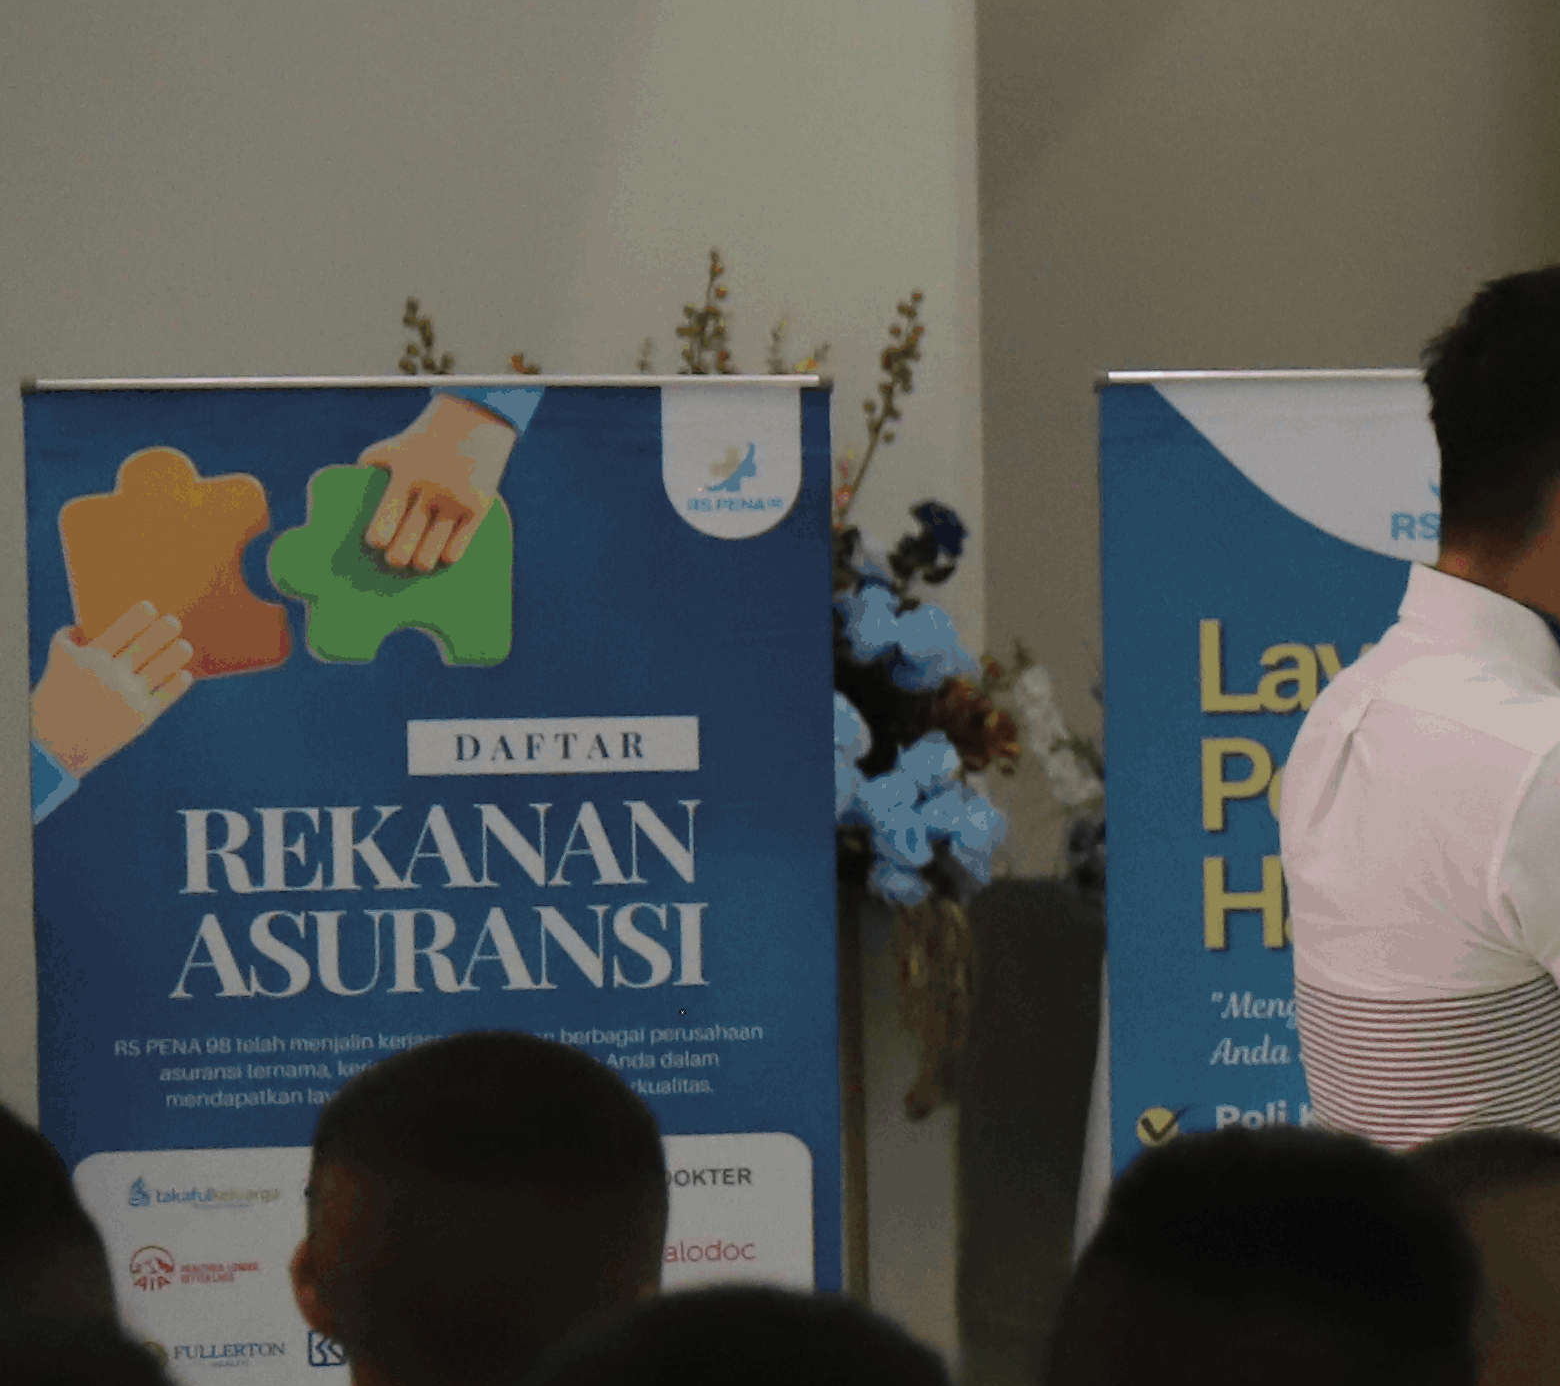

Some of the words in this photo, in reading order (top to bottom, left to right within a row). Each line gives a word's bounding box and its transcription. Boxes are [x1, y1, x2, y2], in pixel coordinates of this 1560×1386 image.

[455, 731, 646, 763] DAFTAR
[177, 799, 702, 895] REKANAN
[1204, 856, 1293, 950] H
[168, 902, 709, 1001] ASURANSI
[114, 1039, 141, 1057] RS
[146, 1038, 202, 1055] PENA
[206, 1037, 231, 1054] 98
[236, 1036, 286, 1053] telah
[290, 1034, 374, 1054] menjalin
[560, 1027, 645, 1047] berbagai
[650, 1025, 763, 1045] perusahaan
[1209, 1033, 1291, 1066] Anda
[160, 1064, 242, 1081] asuransi
[607, 1052, 655, 1069] Anda
[660, 1051, 719, 1068] dalam
[166, 1088, 303, 1109] mendapatkan
[1216, 1099, 1287, 1130] Poli
[663, 1240, 756, 1263] alodoc
[174, 1342, 285, 1359] FULLERTON
